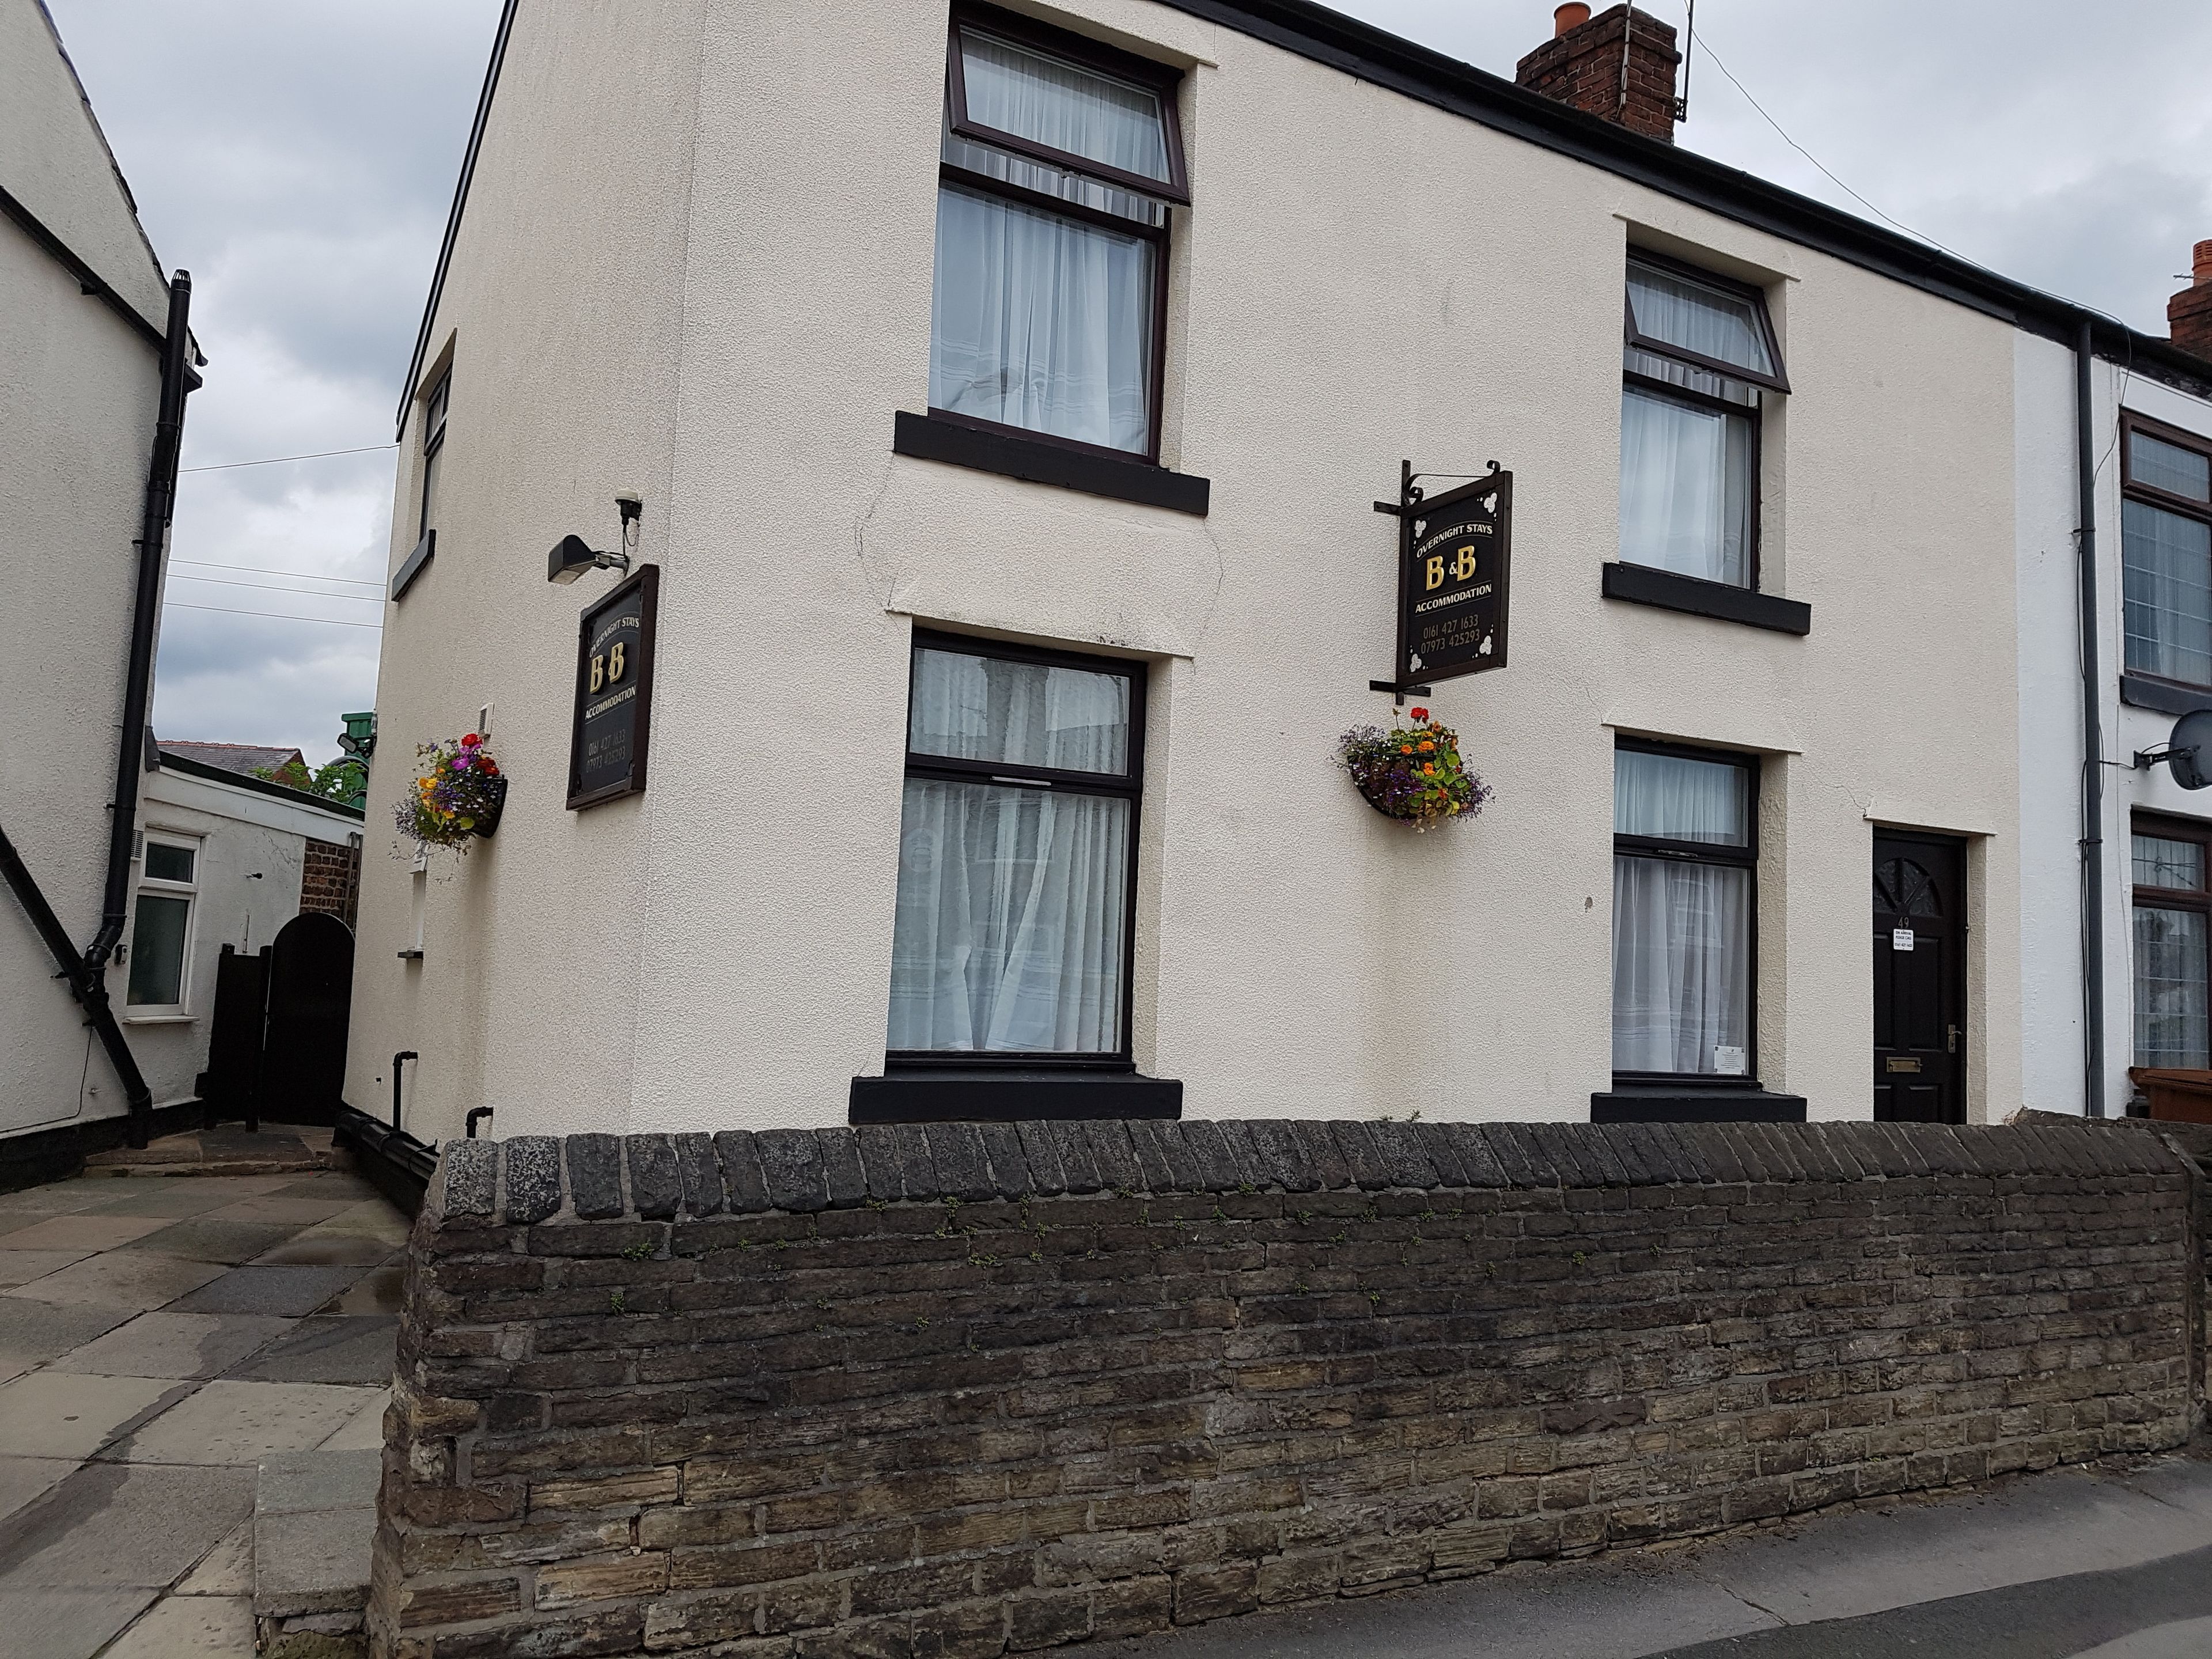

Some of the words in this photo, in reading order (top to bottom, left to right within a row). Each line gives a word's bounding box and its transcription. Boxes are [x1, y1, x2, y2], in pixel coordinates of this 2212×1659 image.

[1416, 525, 1464, 558] OVERNIGHT
[1467, 524, 1493, 535] STAYS
[1415, 583, 1492, 613] ACCOMMODATION
[589, 619, 621, 658] OVERNIGHT
[622, 617, 639, 628] STAYS
[1421, 638, 1445, 654] 07973
[1449, 628, 1480, 647] 425293
[1423, 624, 1438, 639] 0161
[1442, 619, 1457, 635] 427
[1461, 614, 1479, 630] 1633
[585, 685, 636, 720] ACCOMMODATION
[1898, 916, 1909, 929] 49
